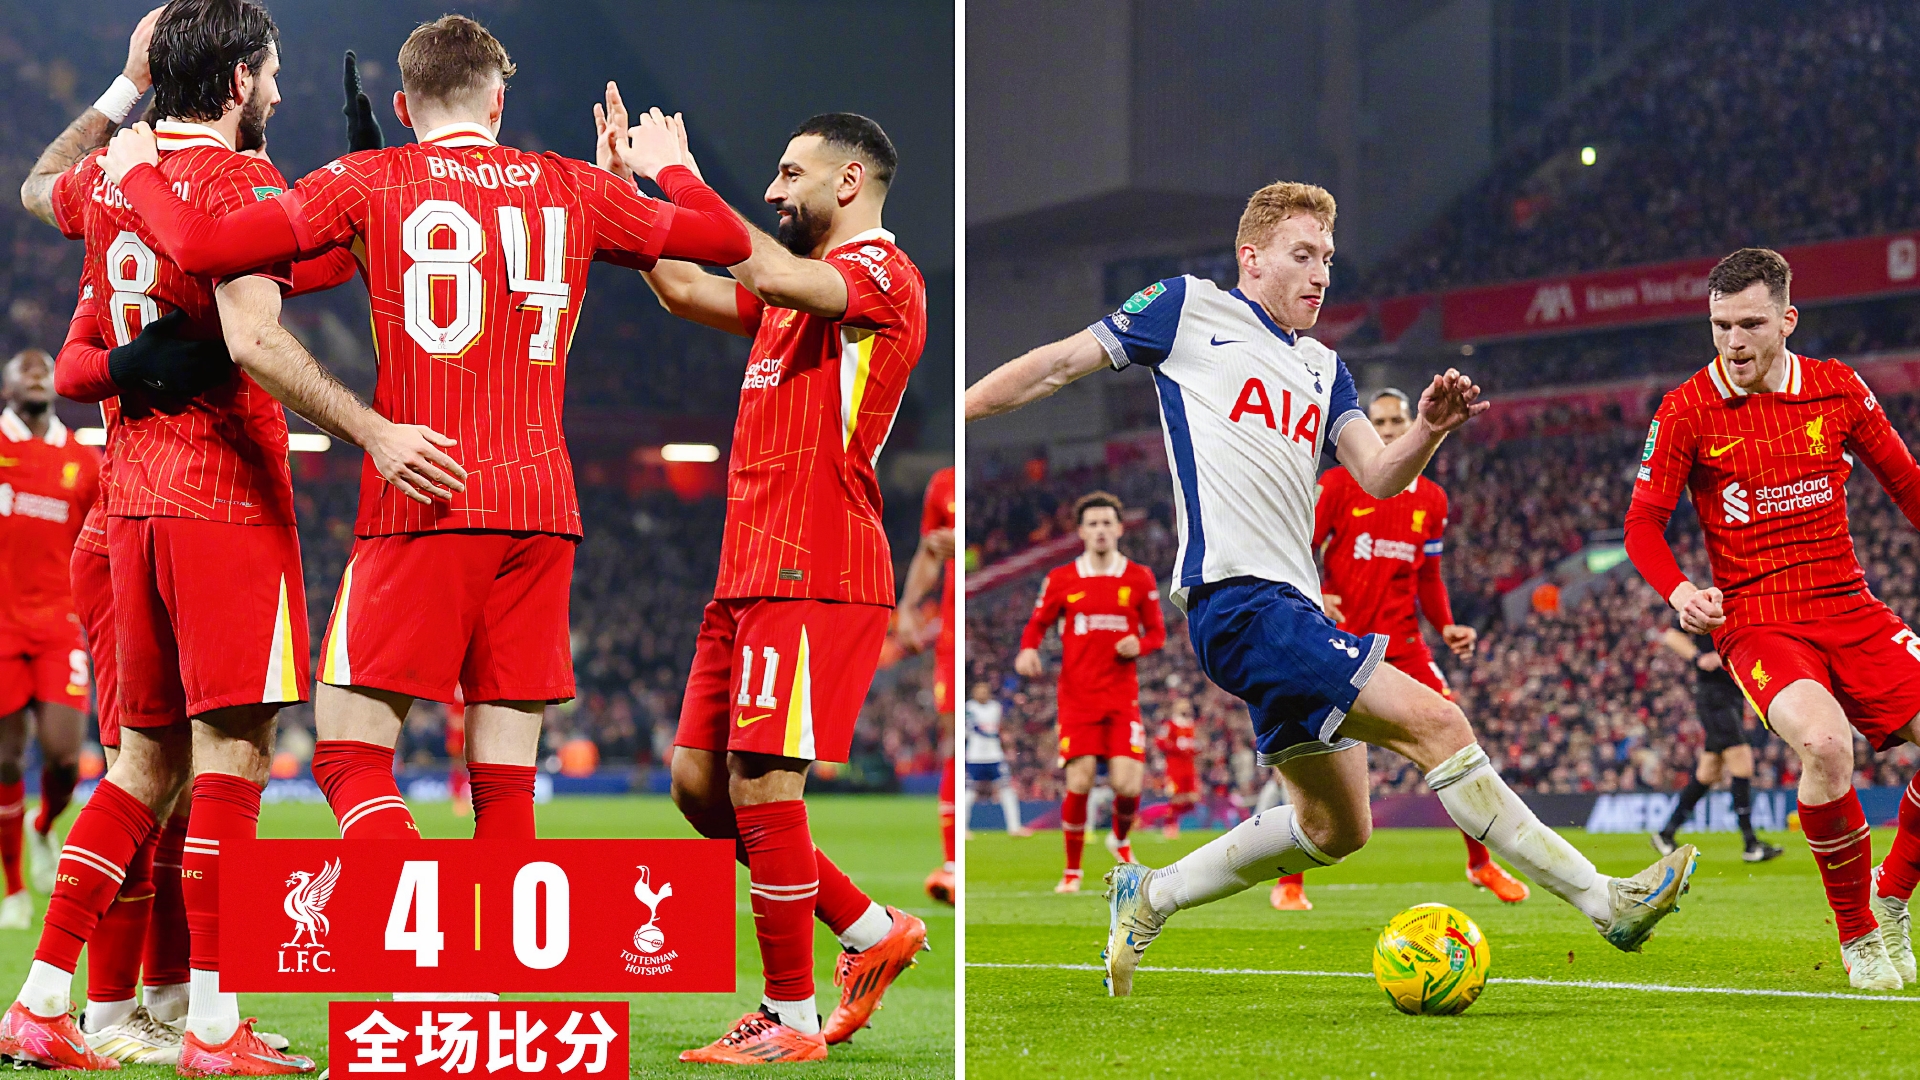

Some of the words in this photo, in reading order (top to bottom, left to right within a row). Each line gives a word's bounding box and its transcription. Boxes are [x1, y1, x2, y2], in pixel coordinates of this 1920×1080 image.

[106, 230, 162, 348] 8
[402, 199, 570, 365] 84
[1228, 377, 1322, 459] AIA
[1755, 474, 1829, 501] standard
[1756, 486, 1833, 515] chartered
[737, 645, 779, 709] 11
[56, 872, 80, 886] LFC
[181, 868, 204, 880] LFC
